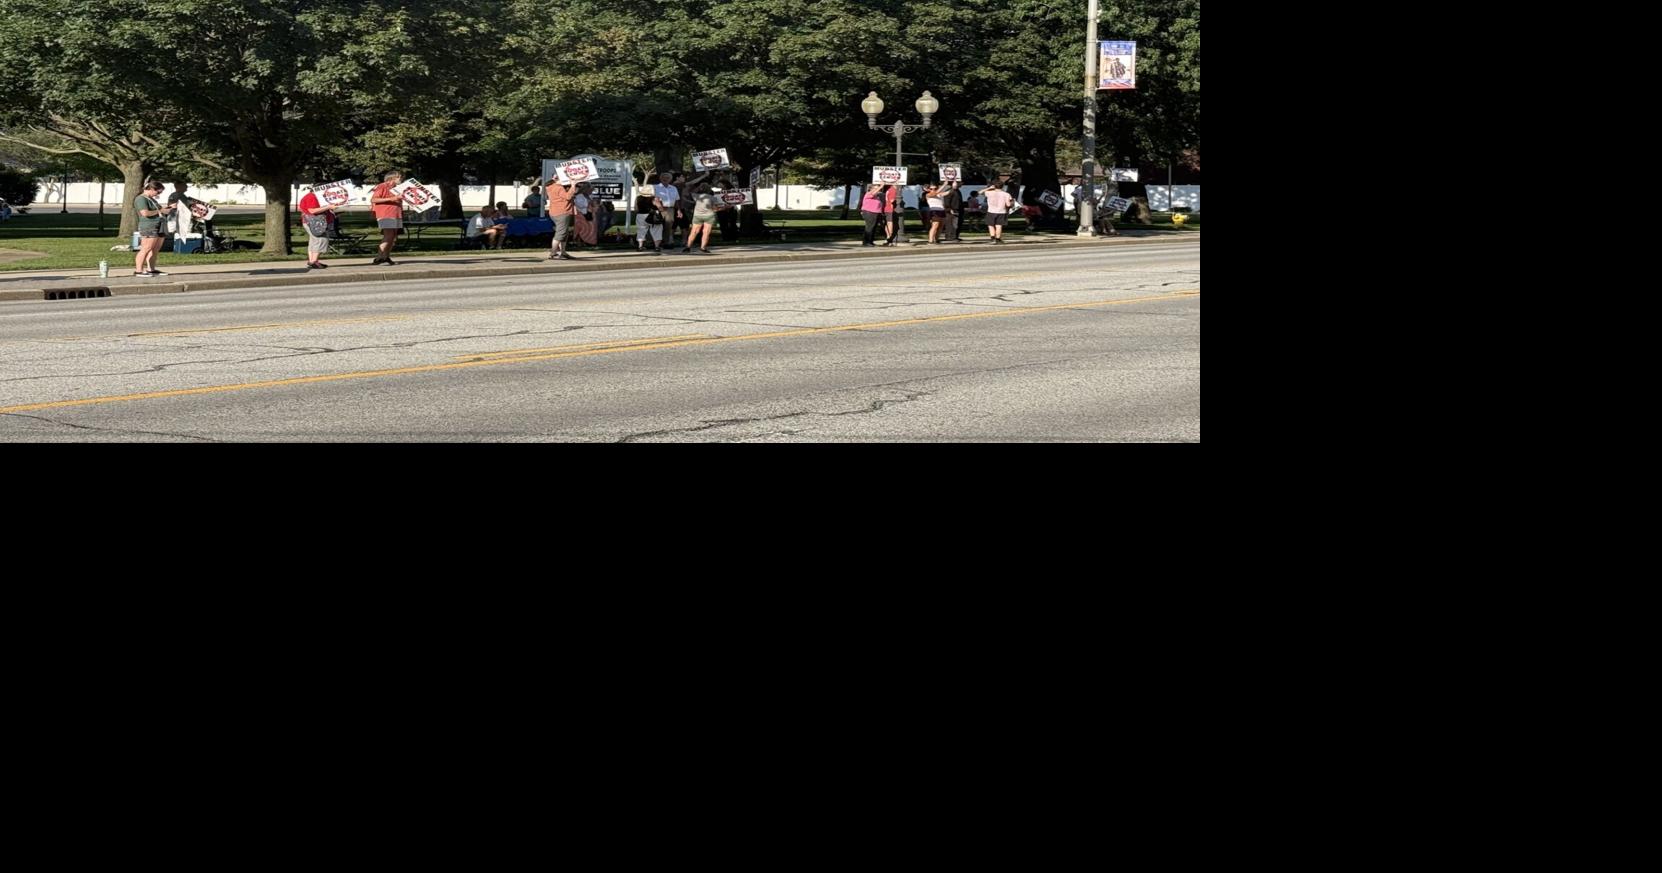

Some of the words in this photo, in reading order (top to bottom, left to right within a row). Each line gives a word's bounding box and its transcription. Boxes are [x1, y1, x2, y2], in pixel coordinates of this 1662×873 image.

[314, 180, 351, 192] MUNSTER
[409, 179, 440, 203] MUNSTER
[591, 187, 621, 195] BLUE
